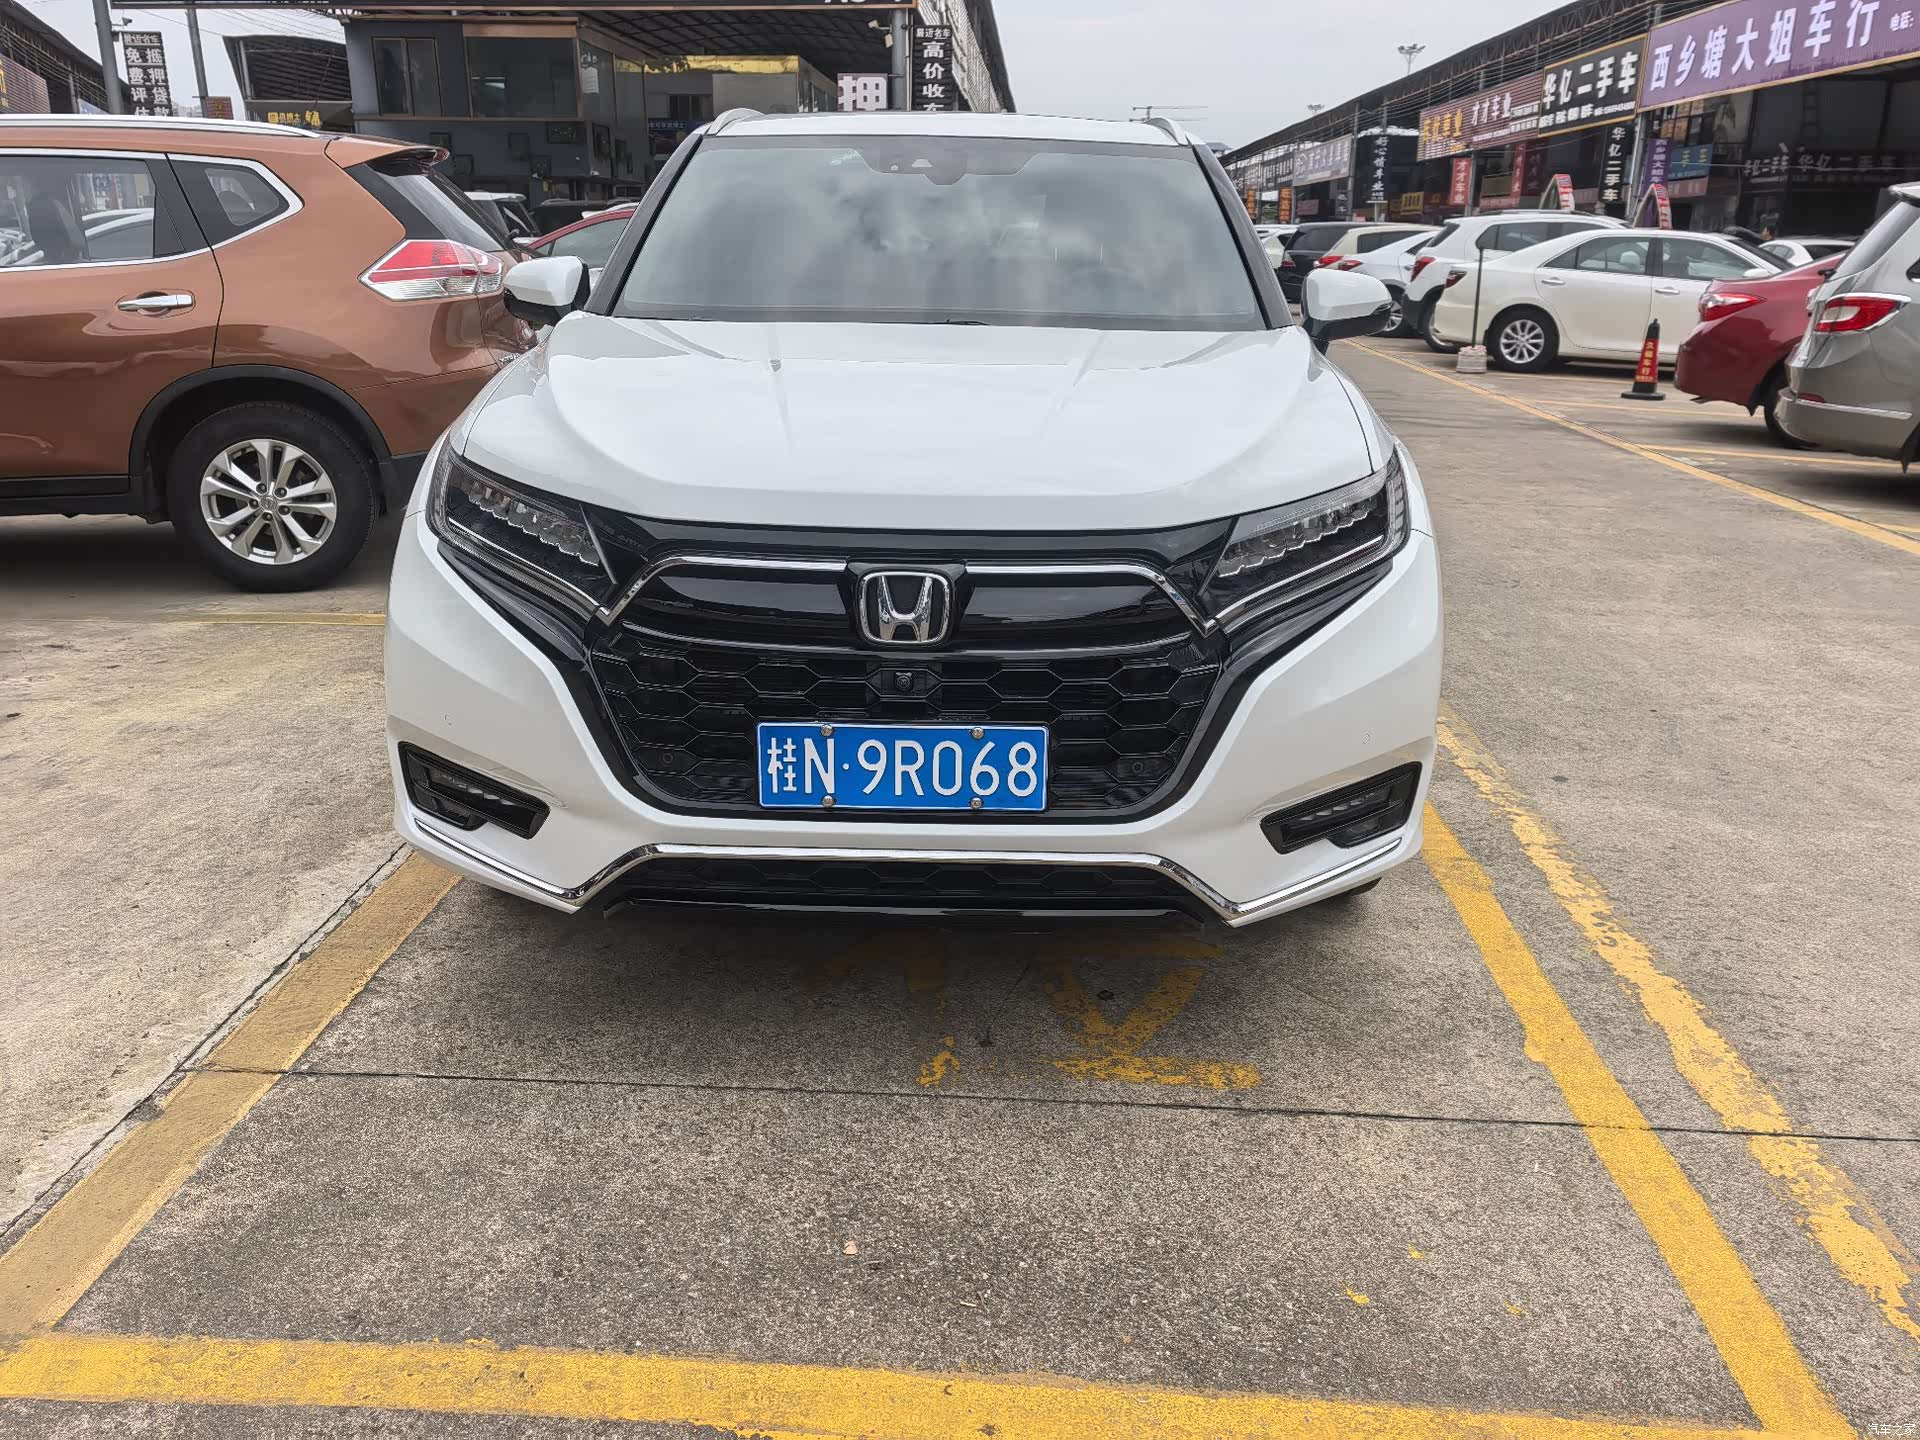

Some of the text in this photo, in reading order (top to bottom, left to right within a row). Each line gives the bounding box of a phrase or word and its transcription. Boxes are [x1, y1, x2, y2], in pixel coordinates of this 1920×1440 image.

[1650, 0, 1880, 91] 西乡塘大姐车行
[1543, 52, 1639, 110] 华亿二手车
[1602, 127, 1626, 201] 华亿二手车
[767, 737, 1039, 797] 桂N·9R068
